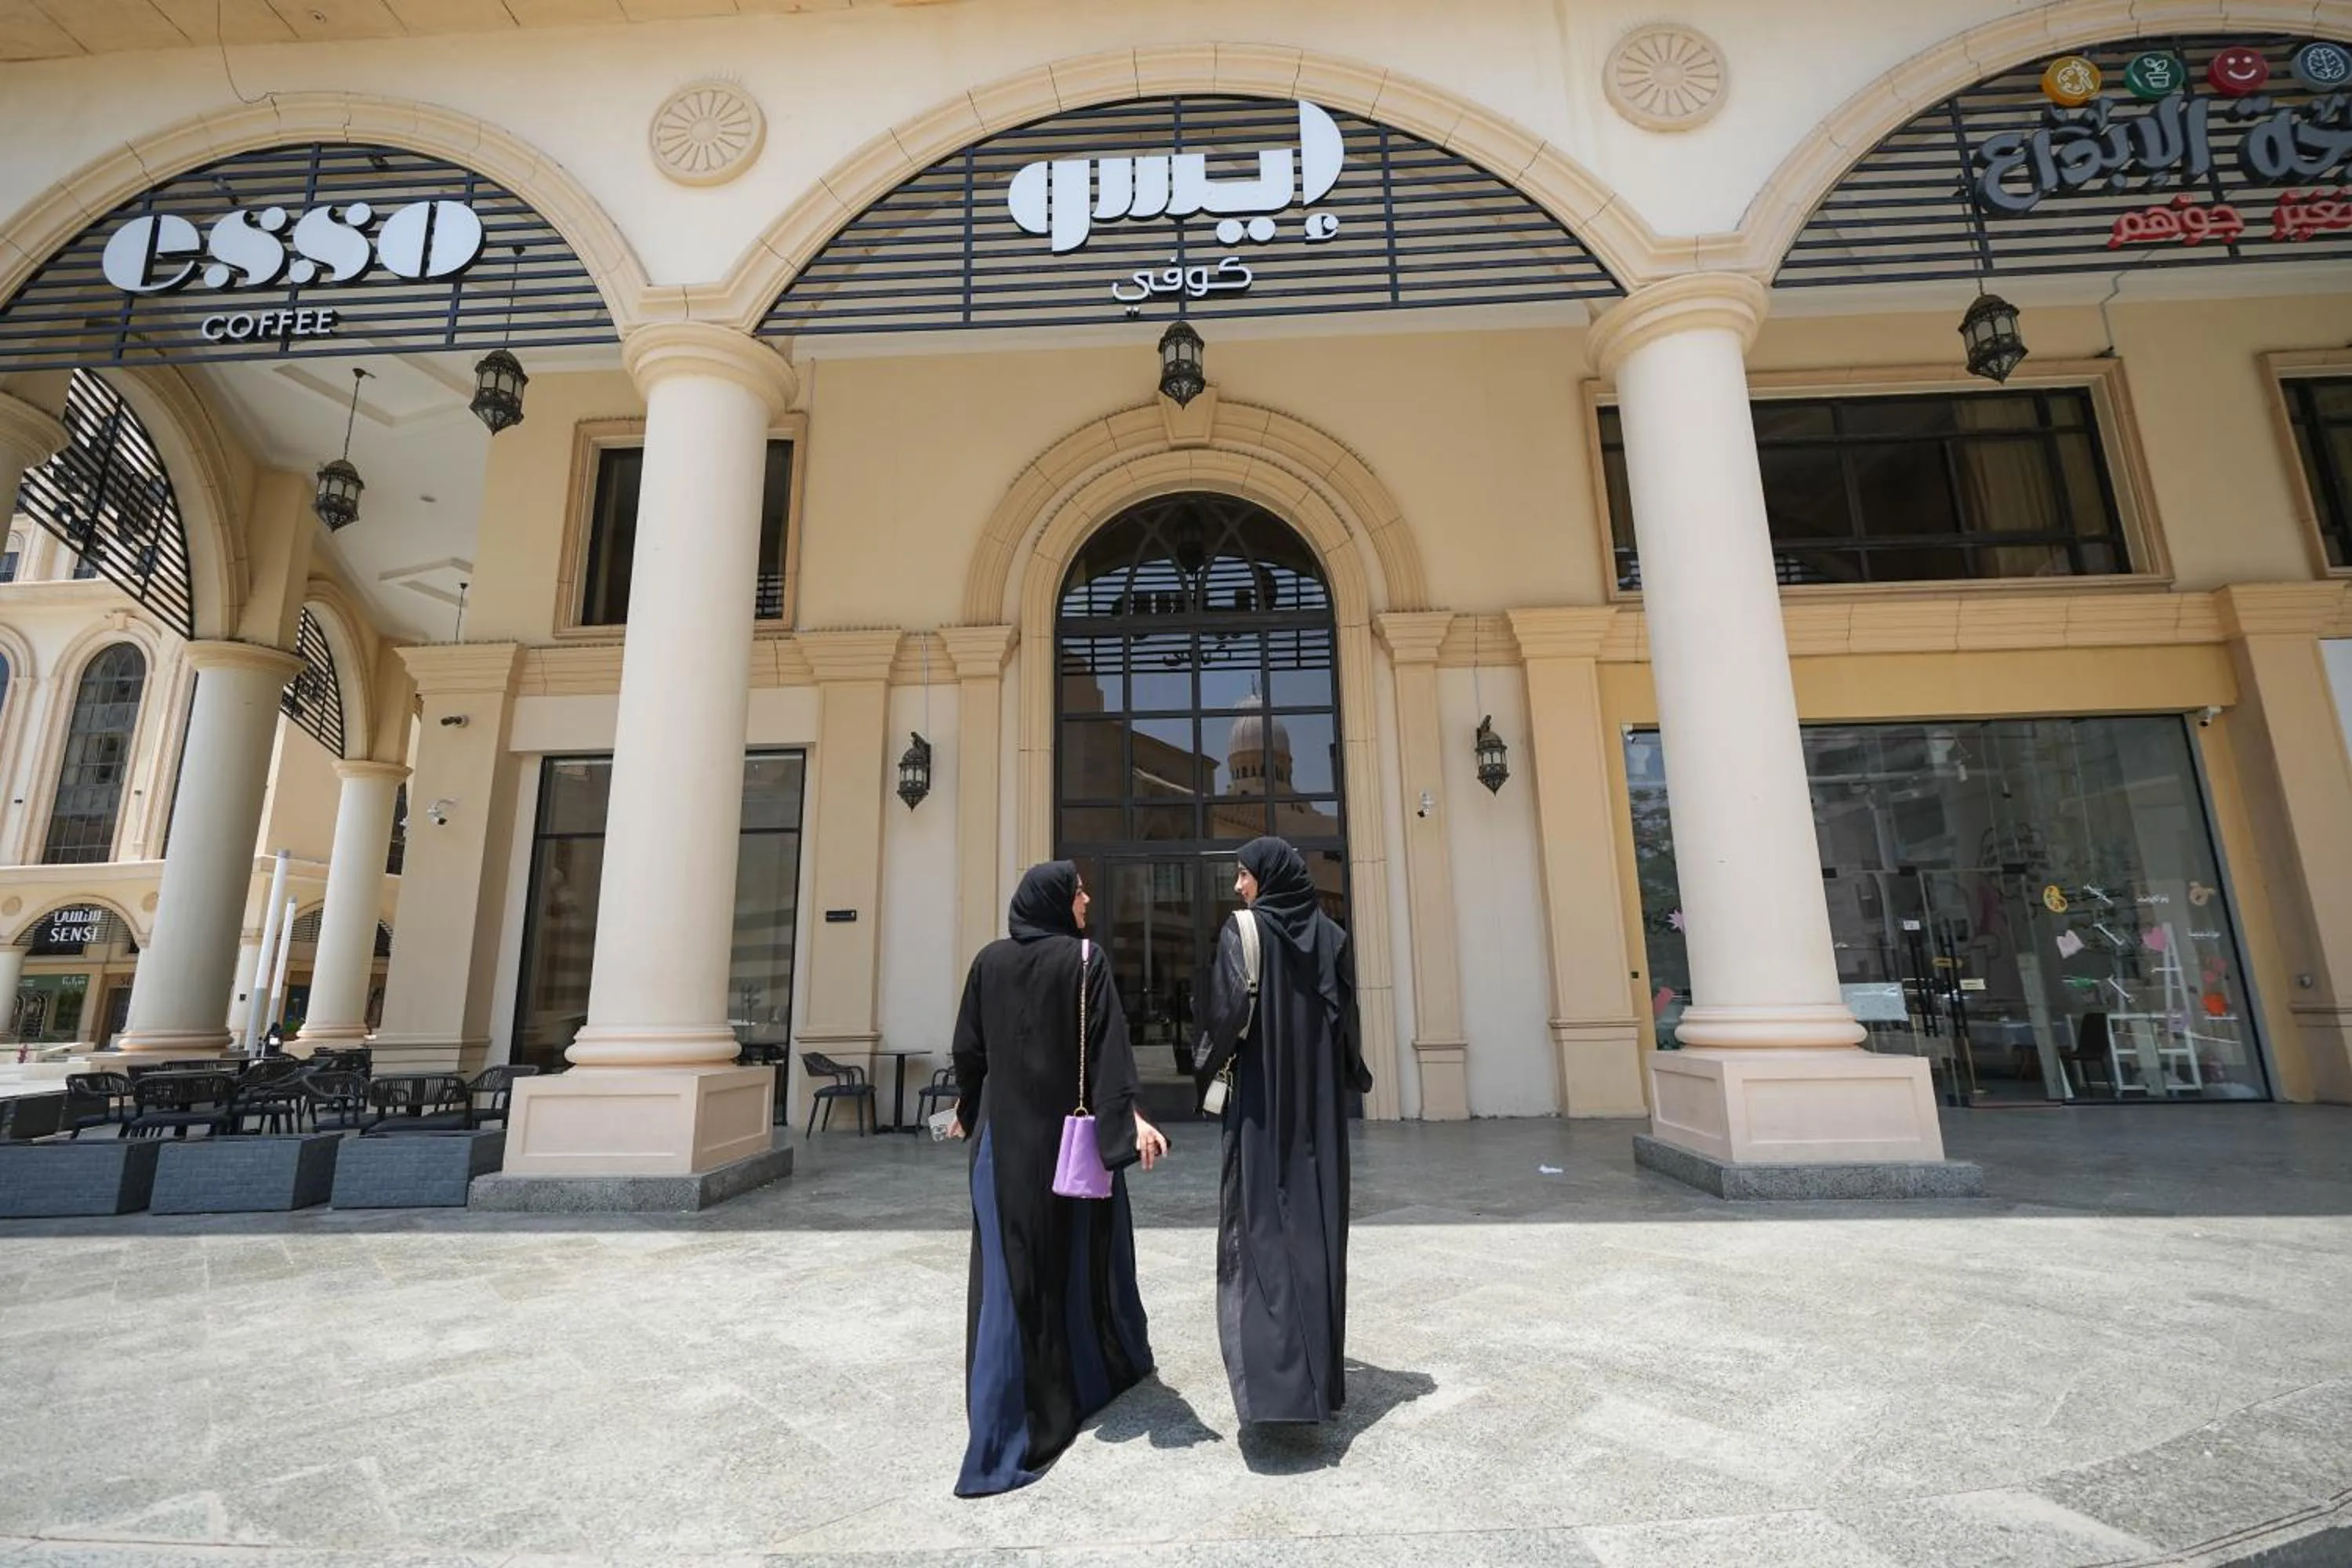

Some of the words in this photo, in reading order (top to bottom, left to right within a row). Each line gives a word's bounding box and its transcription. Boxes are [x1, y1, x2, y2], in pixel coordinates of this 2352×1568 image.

[103, 200, 483, 292] esso
[1112, 256, 1253, 317] كوفي
[202, 310, 334, 339] COFFEE
[49, 926, 99, 942] SENSI
